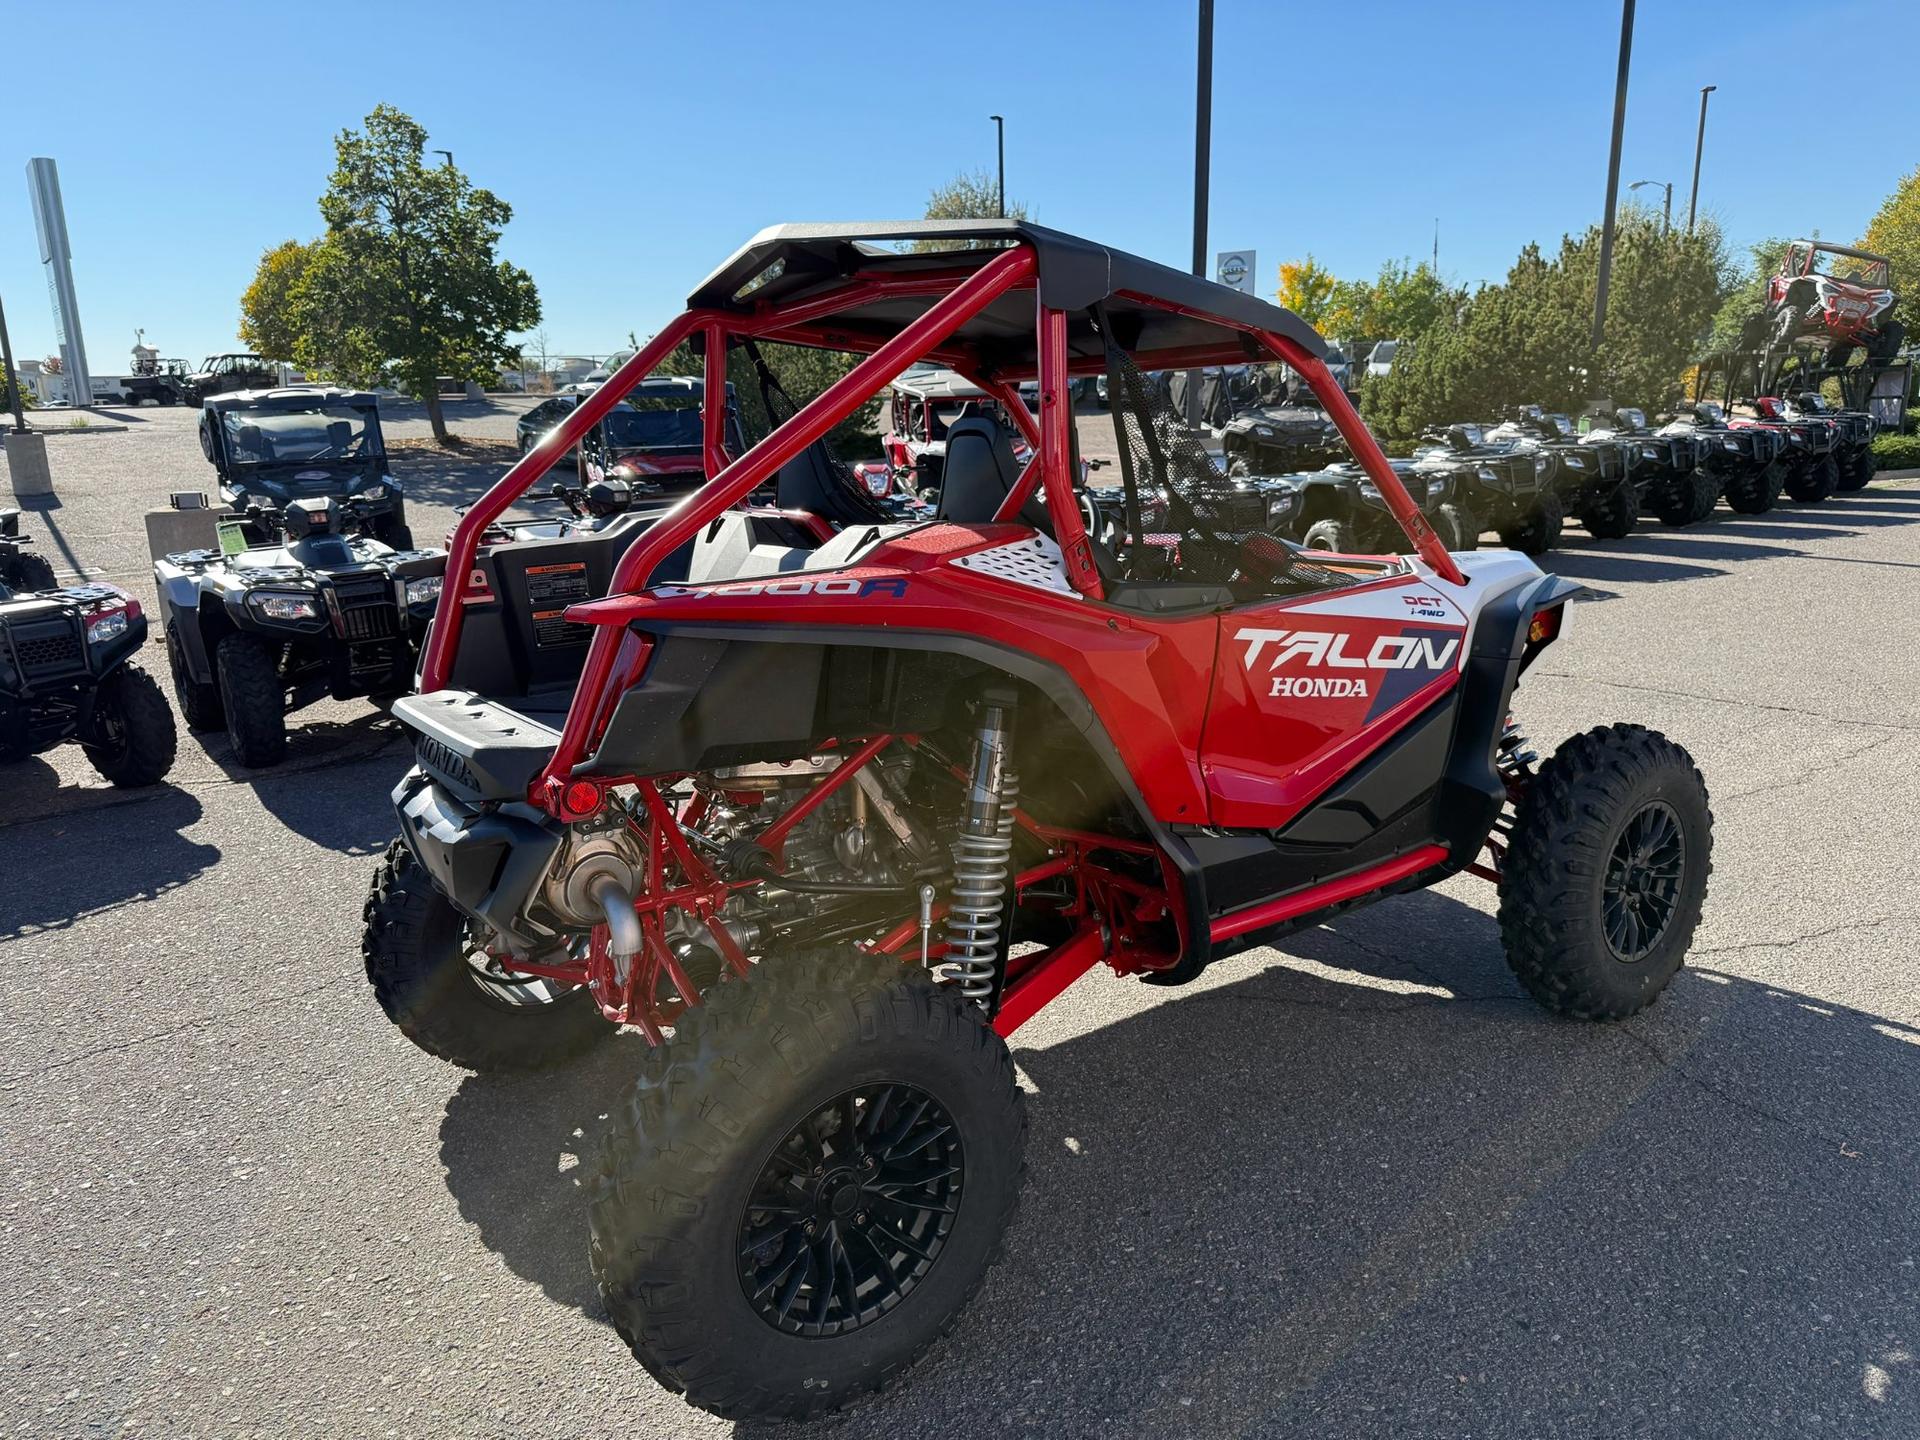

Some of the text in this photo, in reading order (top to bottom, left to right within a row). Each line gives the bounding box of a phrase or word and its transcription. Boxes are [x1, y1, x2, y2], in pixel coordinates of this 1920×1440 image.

[1401, 595, 1443, 608] DCT
[1233, 627, 1460, 673] TALON
[1268, 677, 1368, 698] HONDA
